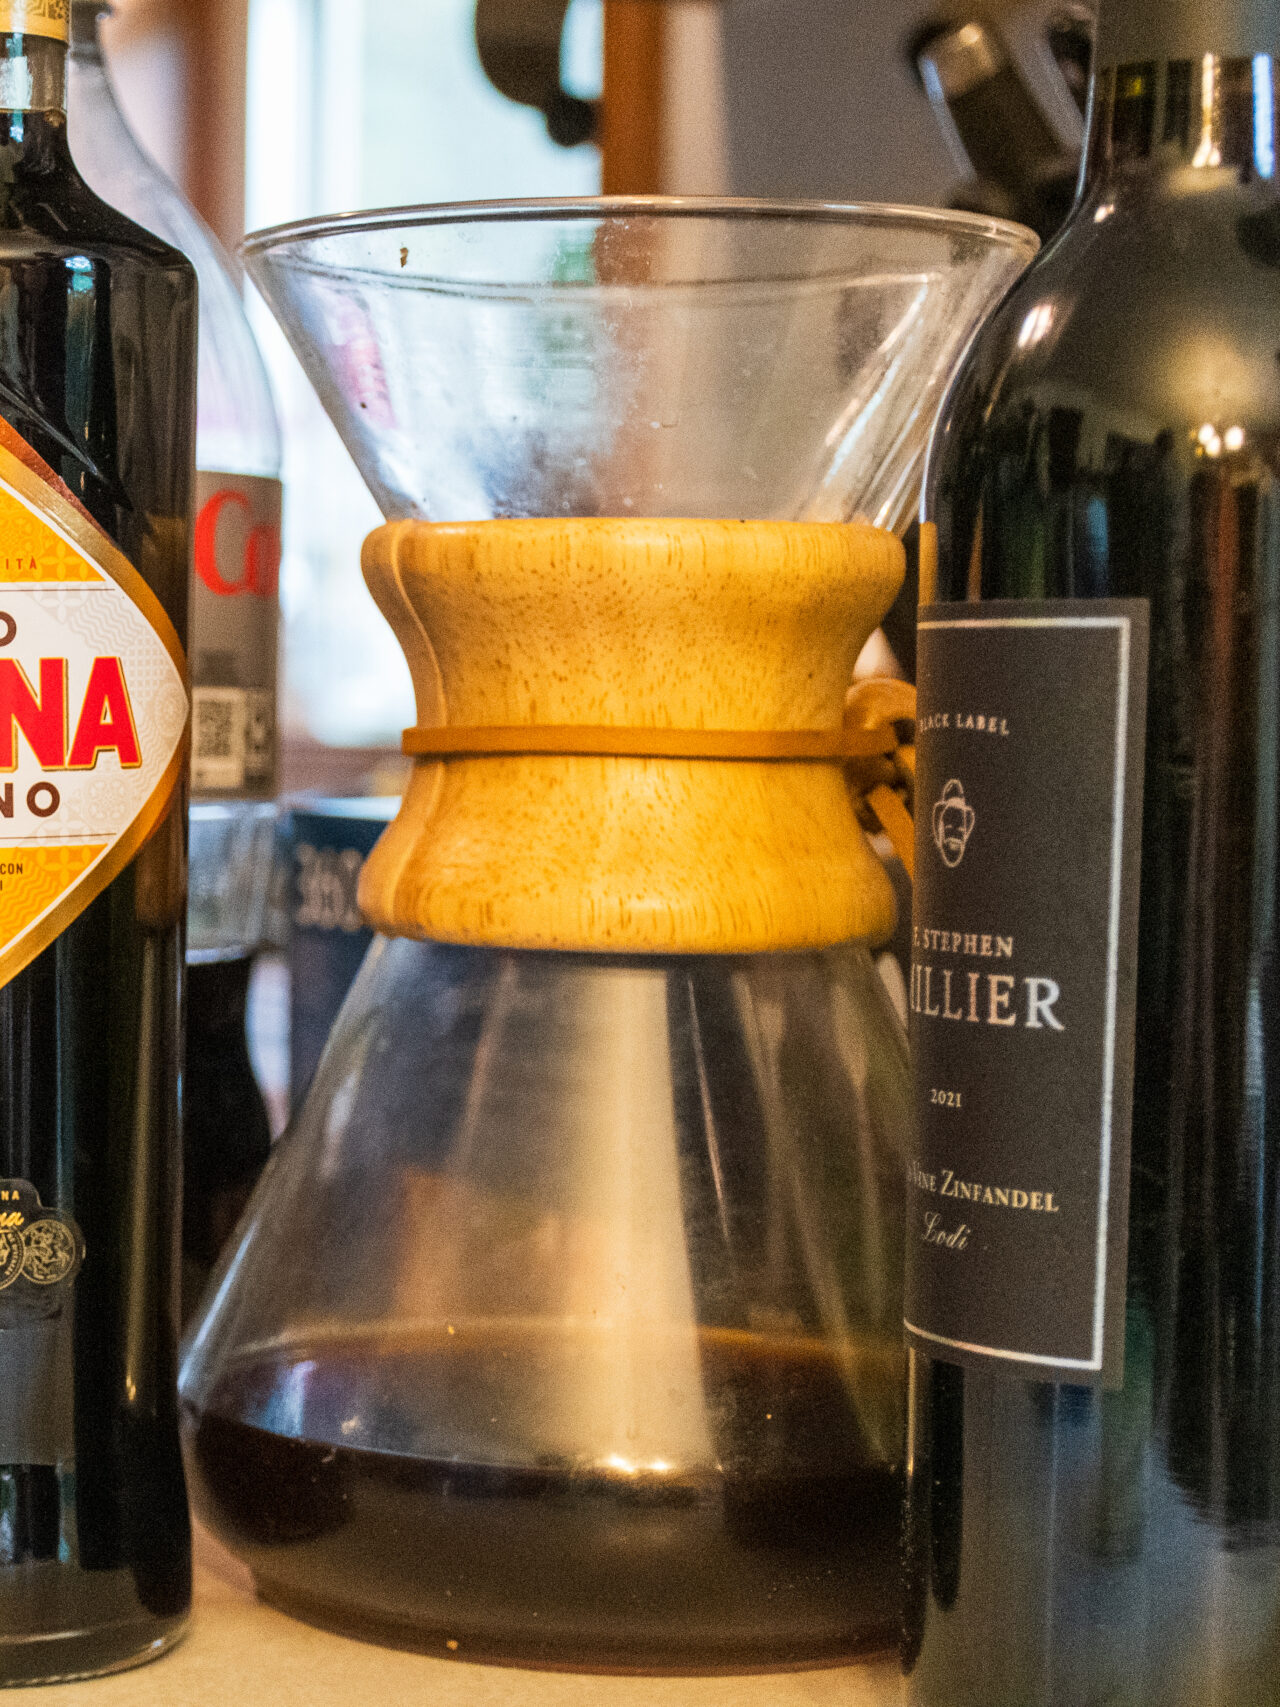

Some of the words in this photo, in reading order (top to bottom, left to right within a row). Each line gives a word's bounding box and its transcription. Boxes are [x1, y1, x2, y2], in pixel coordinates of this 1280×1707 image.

[956, 713, 1010, 736] LABEL
[0, 862, 24, 875] CON
[923, 928, 1014, 958] STEPHEN
[930, 1088, 963, 1108] 2021
[940, 1170, 1060, 1213] ZINFANDEL
[922, 1211, 971, 1250] Lodi
